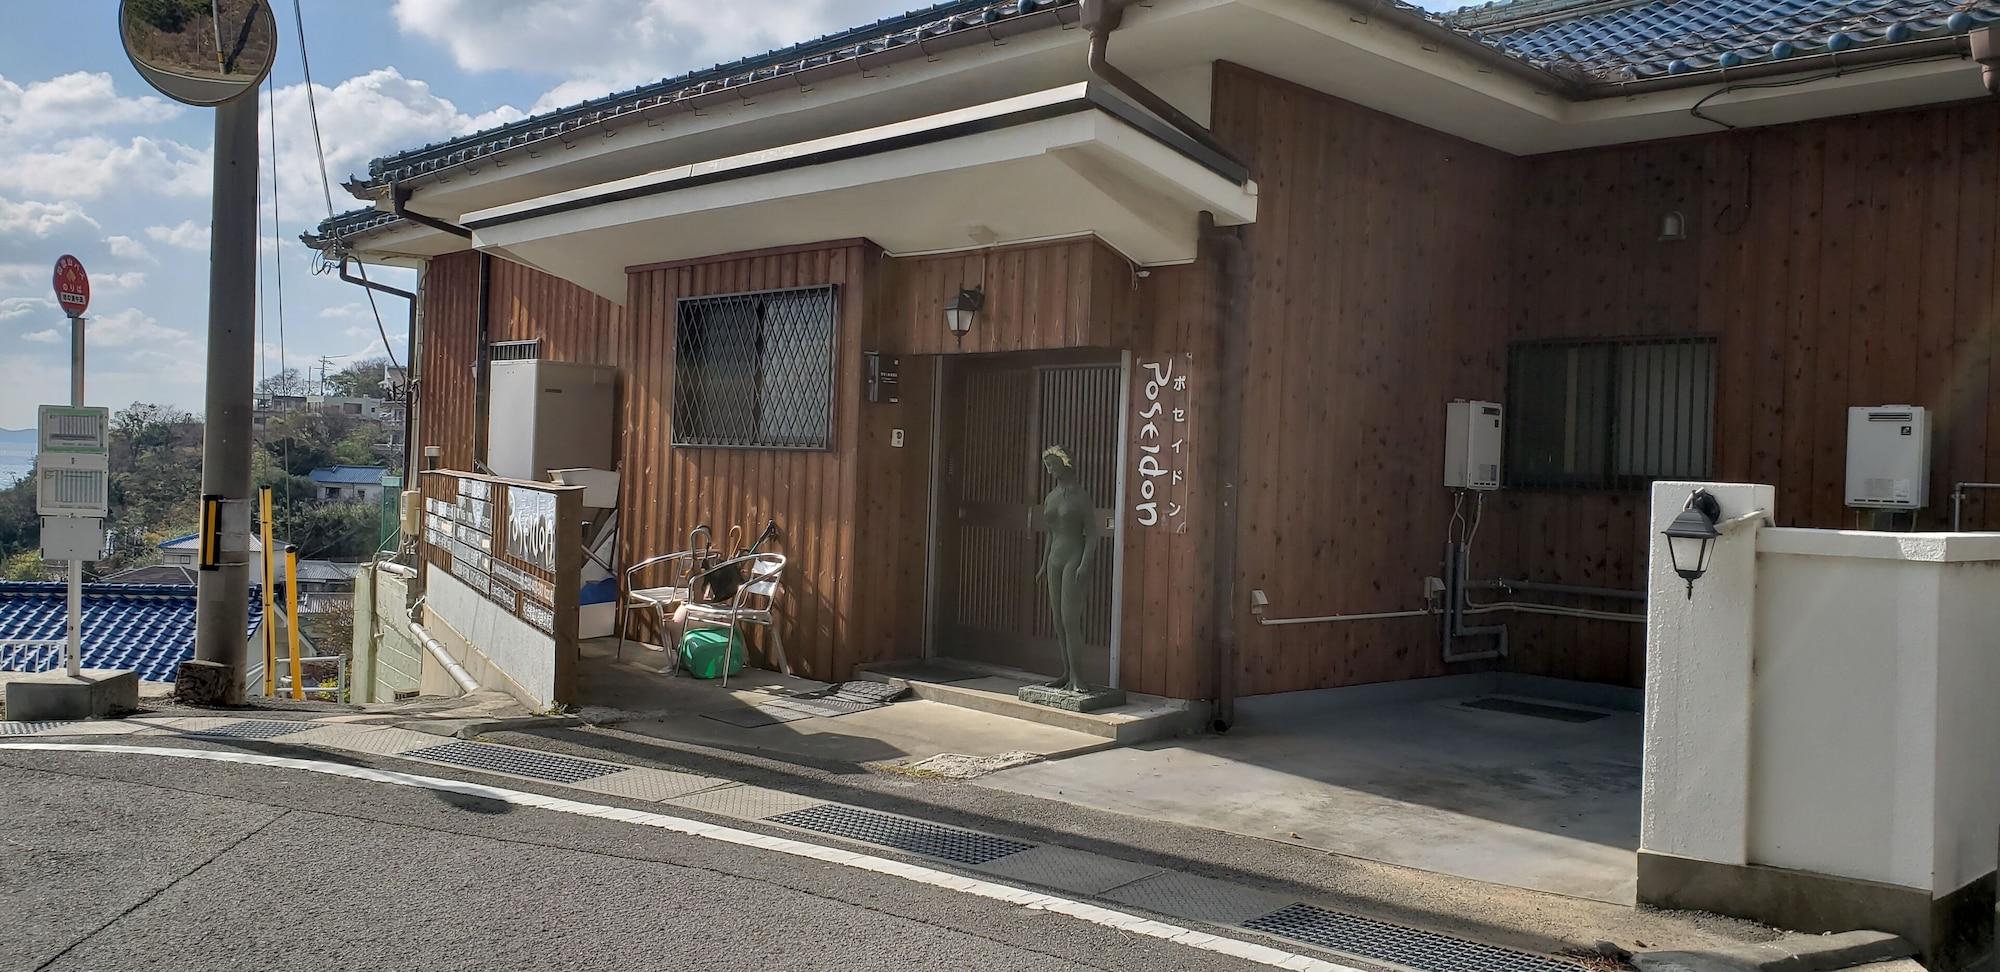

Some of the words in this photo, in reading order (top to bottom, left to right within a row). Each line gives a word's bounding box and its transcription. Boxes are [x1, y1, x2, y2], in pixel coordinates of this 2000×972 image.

[1168, 375, 1187, 518] ポセイドン
